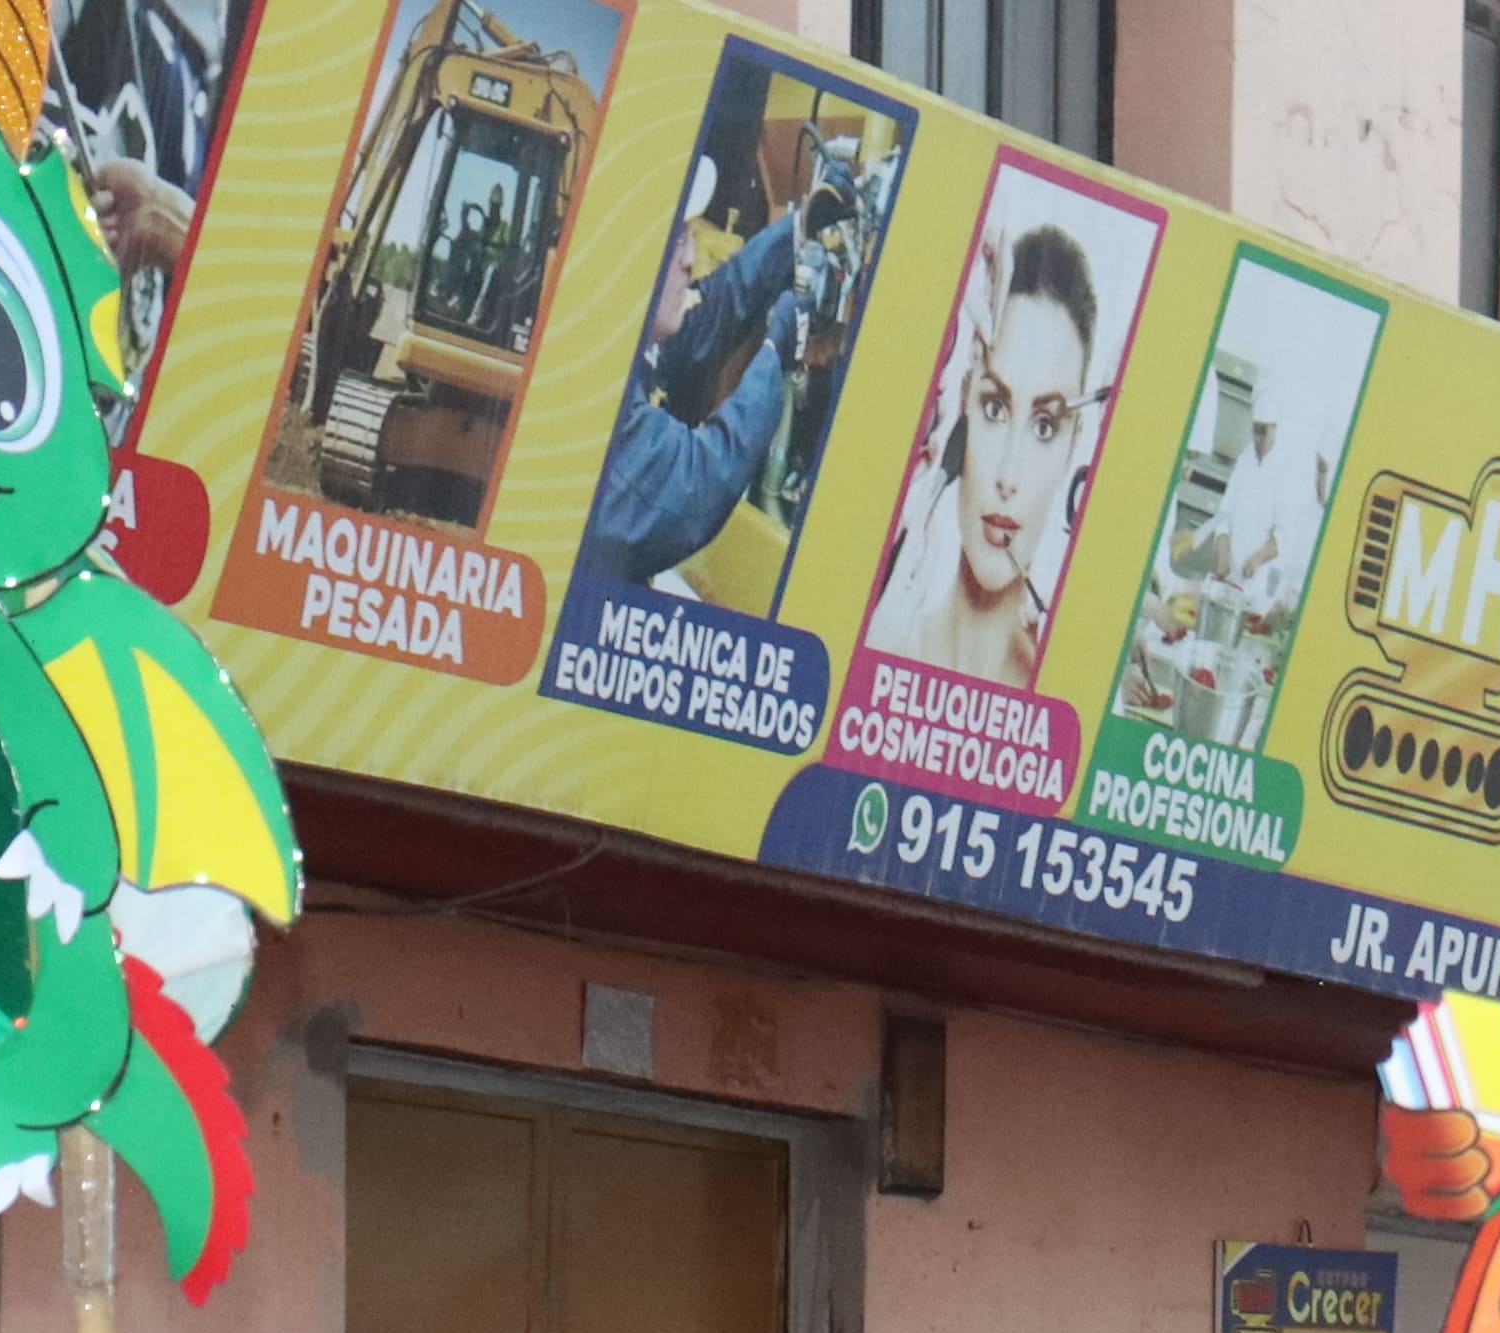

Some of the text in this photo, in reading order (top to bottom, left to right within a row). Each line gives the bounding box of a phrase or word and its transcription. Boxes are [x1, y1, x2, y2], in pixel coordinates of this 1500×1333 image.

[255, 498, 525, 619] MAQUINARIA
[300, 573, 464, 664] PESADA
[599, 598, 795, 695] MECÁNICA DE
[555, 641, 817, 751] EQUIPOS PESADOS
[870, 663, 1050, 752] PELUQUERIA
[838, 708, 1065, 805] COSMETOLOGIA
[1142, 732, 1254, 802] COCINA
[897, 793, 1198, 923] 915 153545
[1088, 771, 1285, 863] PROFESIONAL
[1330, 902, 1396, 974] JR.
[1286, 1270, 1383, 1328] Crecer
